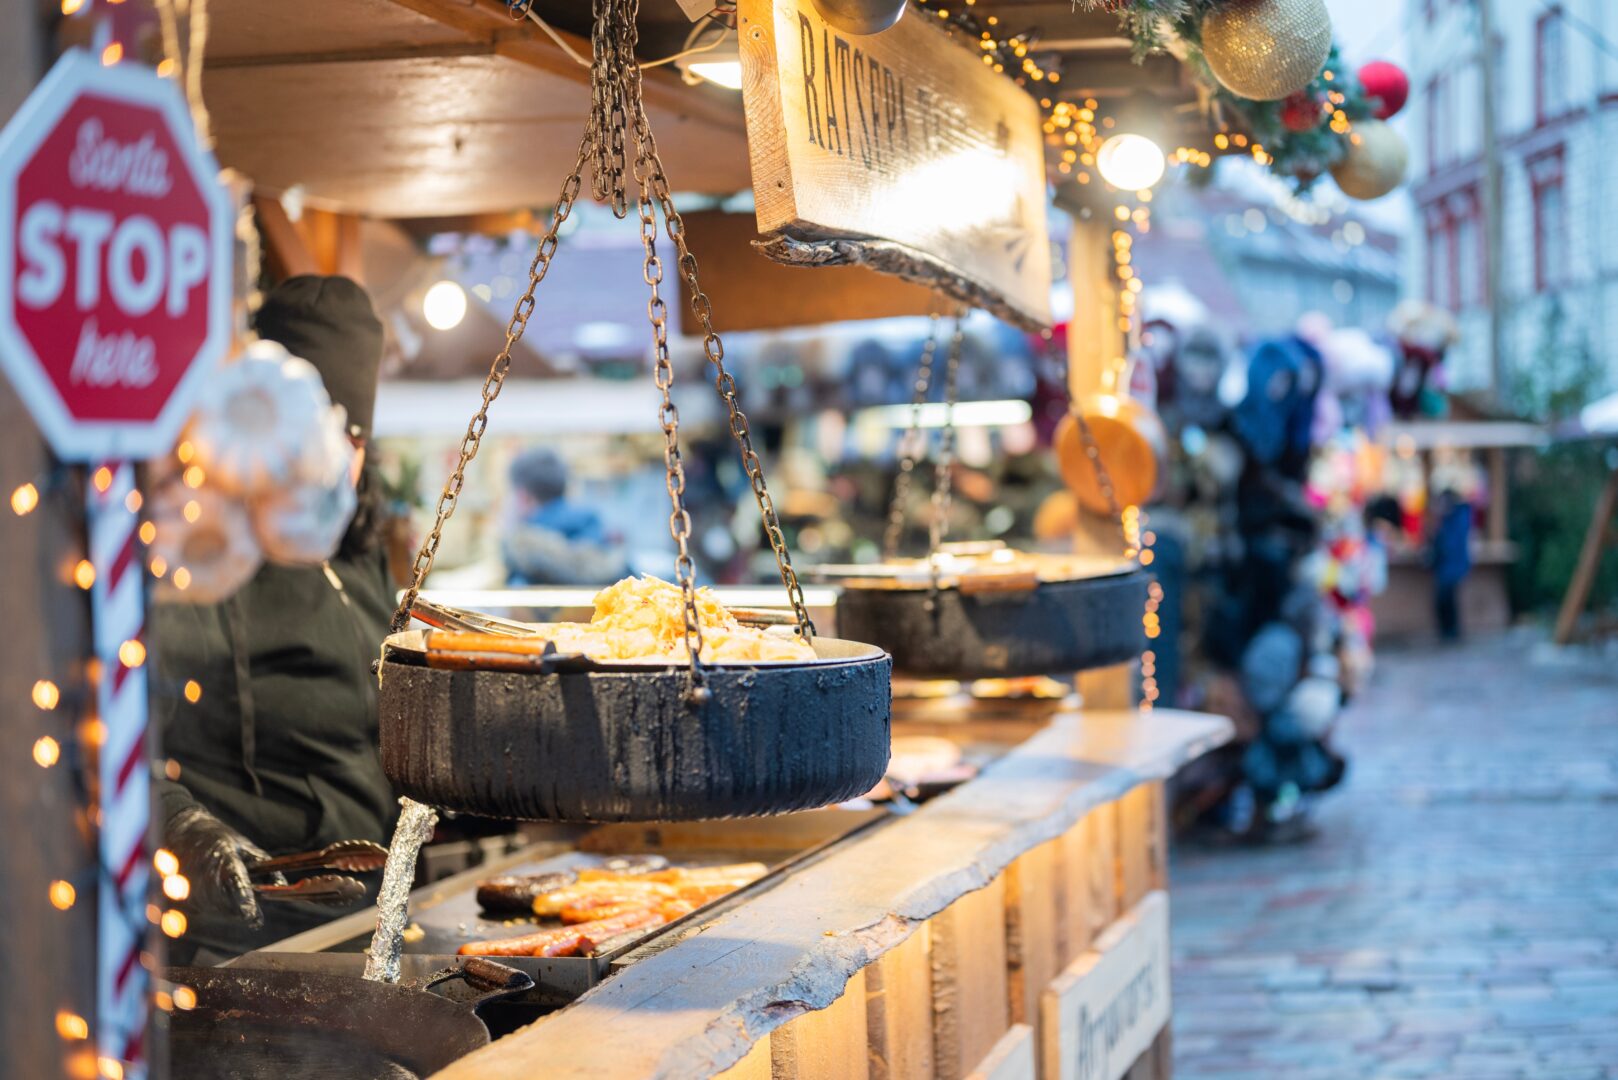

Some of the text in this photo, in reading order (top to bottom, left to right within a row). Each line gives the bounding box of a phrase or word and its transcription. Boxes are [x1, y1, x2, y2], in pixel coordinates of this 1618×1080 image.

[69, 116, 172, 198] Santa
[17, 200, 209, 318] STOP
[70, 315, 161, 389] here
